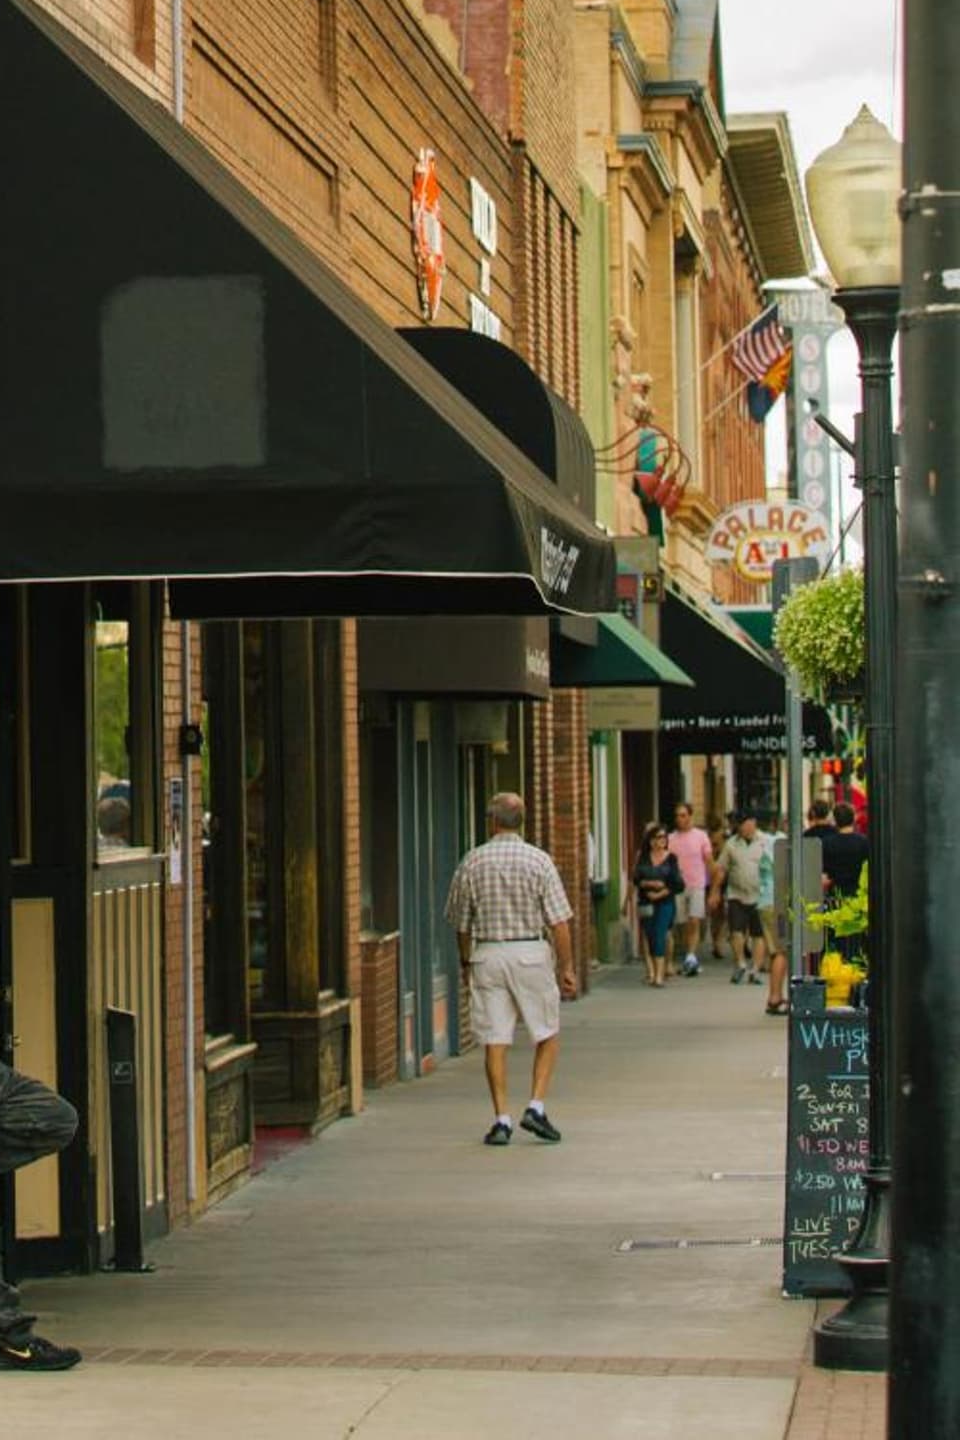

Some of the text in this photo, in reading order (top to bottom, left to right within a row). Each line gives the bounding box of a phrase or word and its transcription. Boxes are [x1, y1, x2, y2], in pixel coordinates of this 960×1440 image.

[712, 506, 827, 557] PALACE
[698, 714, 721, 727] Beer
[800, 1020, 869, 1050] WHISK
[796, 1084, 817, 1100] 2
[845, 1139, 870, 1154] WE
[794, 1214, 832, 1233] LIVE
